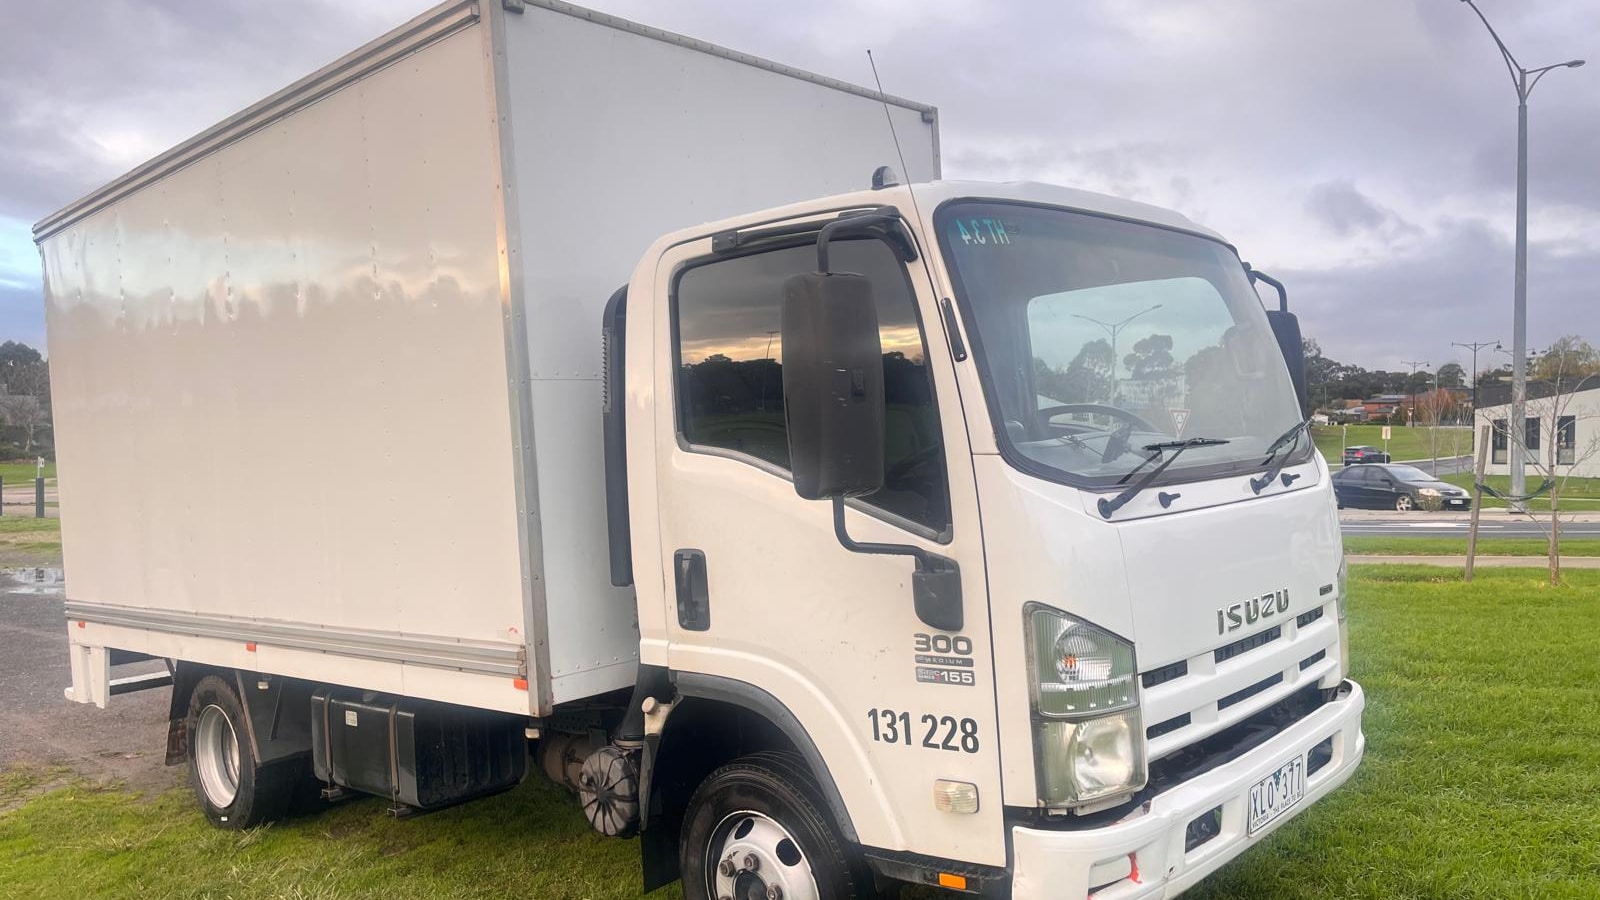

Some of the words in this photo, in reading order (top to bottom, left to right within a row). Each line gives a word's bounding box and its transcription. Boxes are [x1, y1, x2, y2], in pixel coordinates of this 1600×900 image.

[1217, 587, 1289, 635] ISUZU
[914, 633, 973, 655] 300
[941, 671, 973, 683] 155
[868, 708, 912, 746] 131
[921, 714, 980, 754] 228
[1283, 762, 1301, 800] 377
